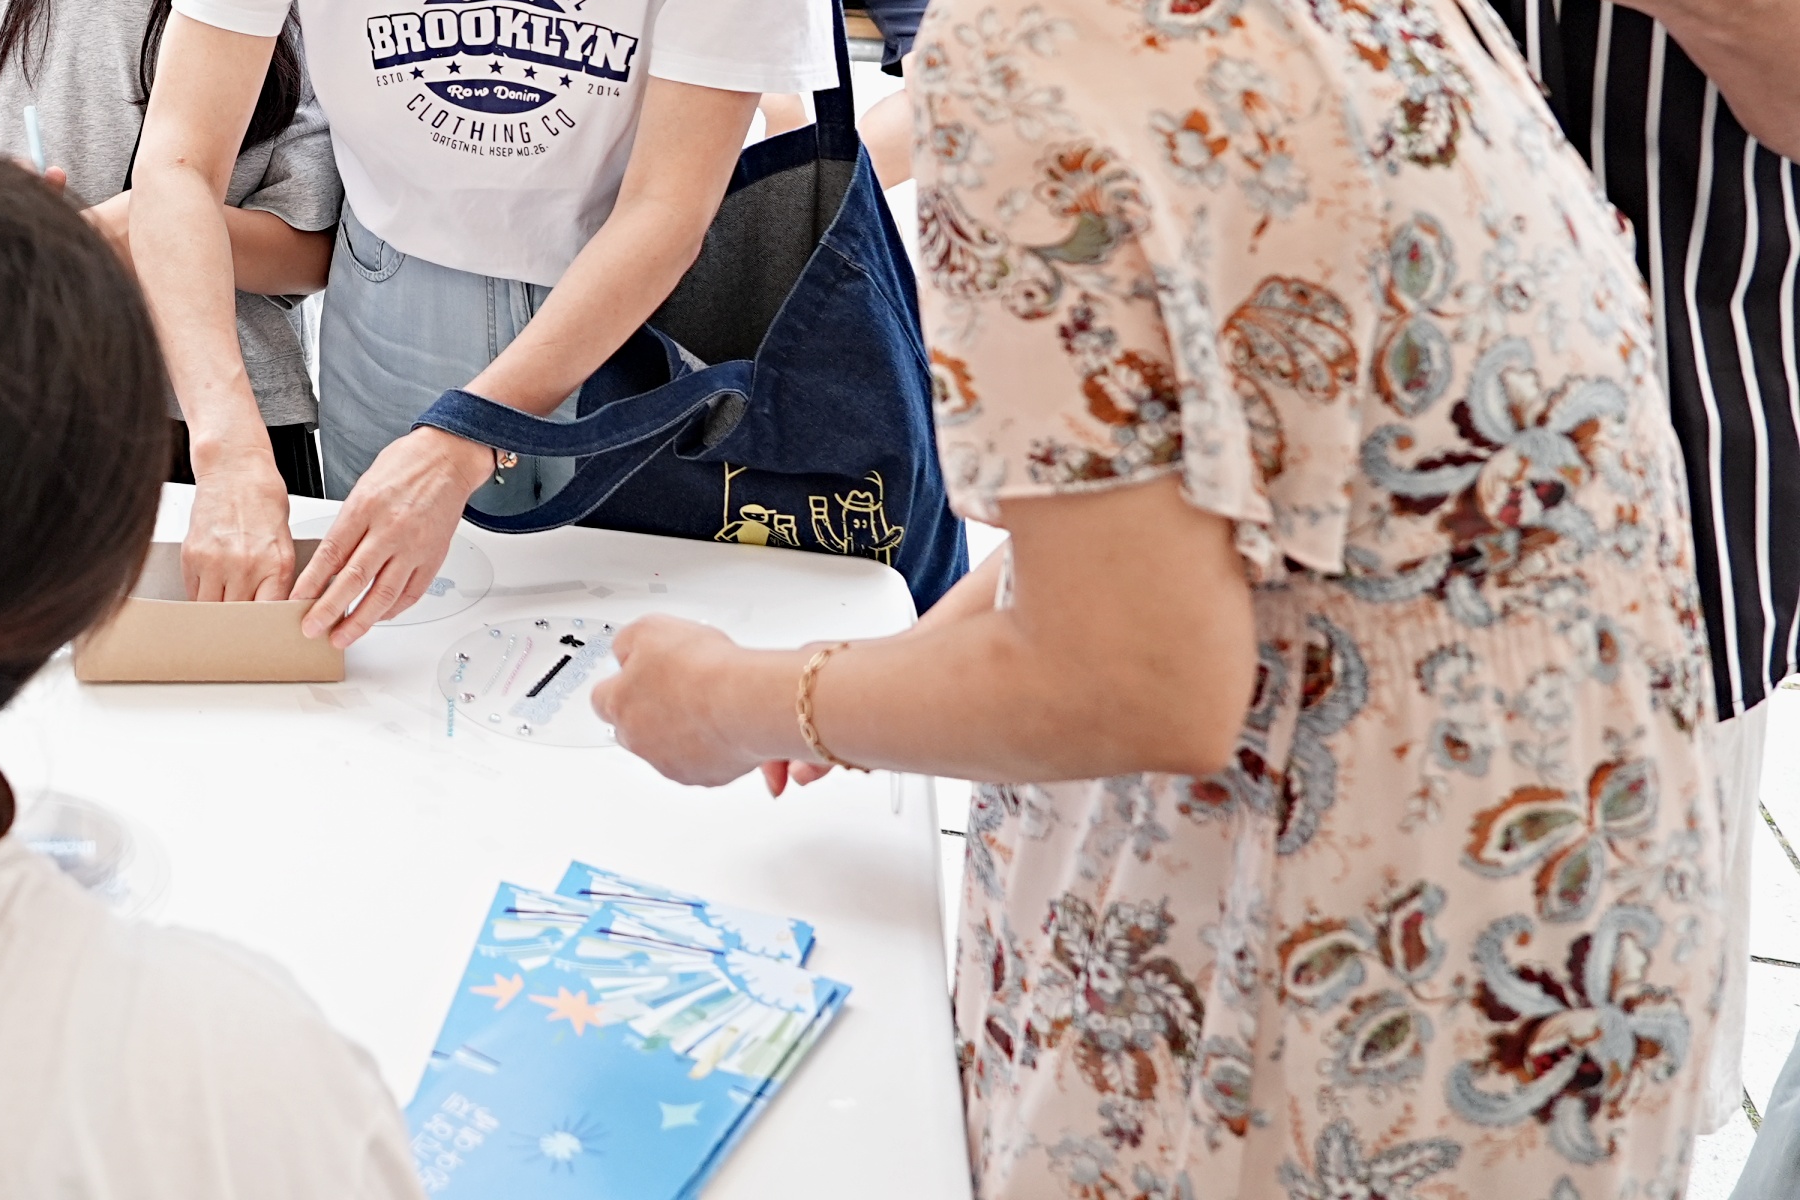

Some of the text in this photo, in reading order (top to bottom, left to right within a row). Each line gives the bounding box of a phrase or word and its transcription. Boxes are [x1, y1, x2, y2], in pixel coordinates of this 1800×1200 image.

[366, 5, 639, 83] BROOKLYN
[587, 82, 621, 98] 2014
[406, 92, 576, 144] CLOTHING CO
